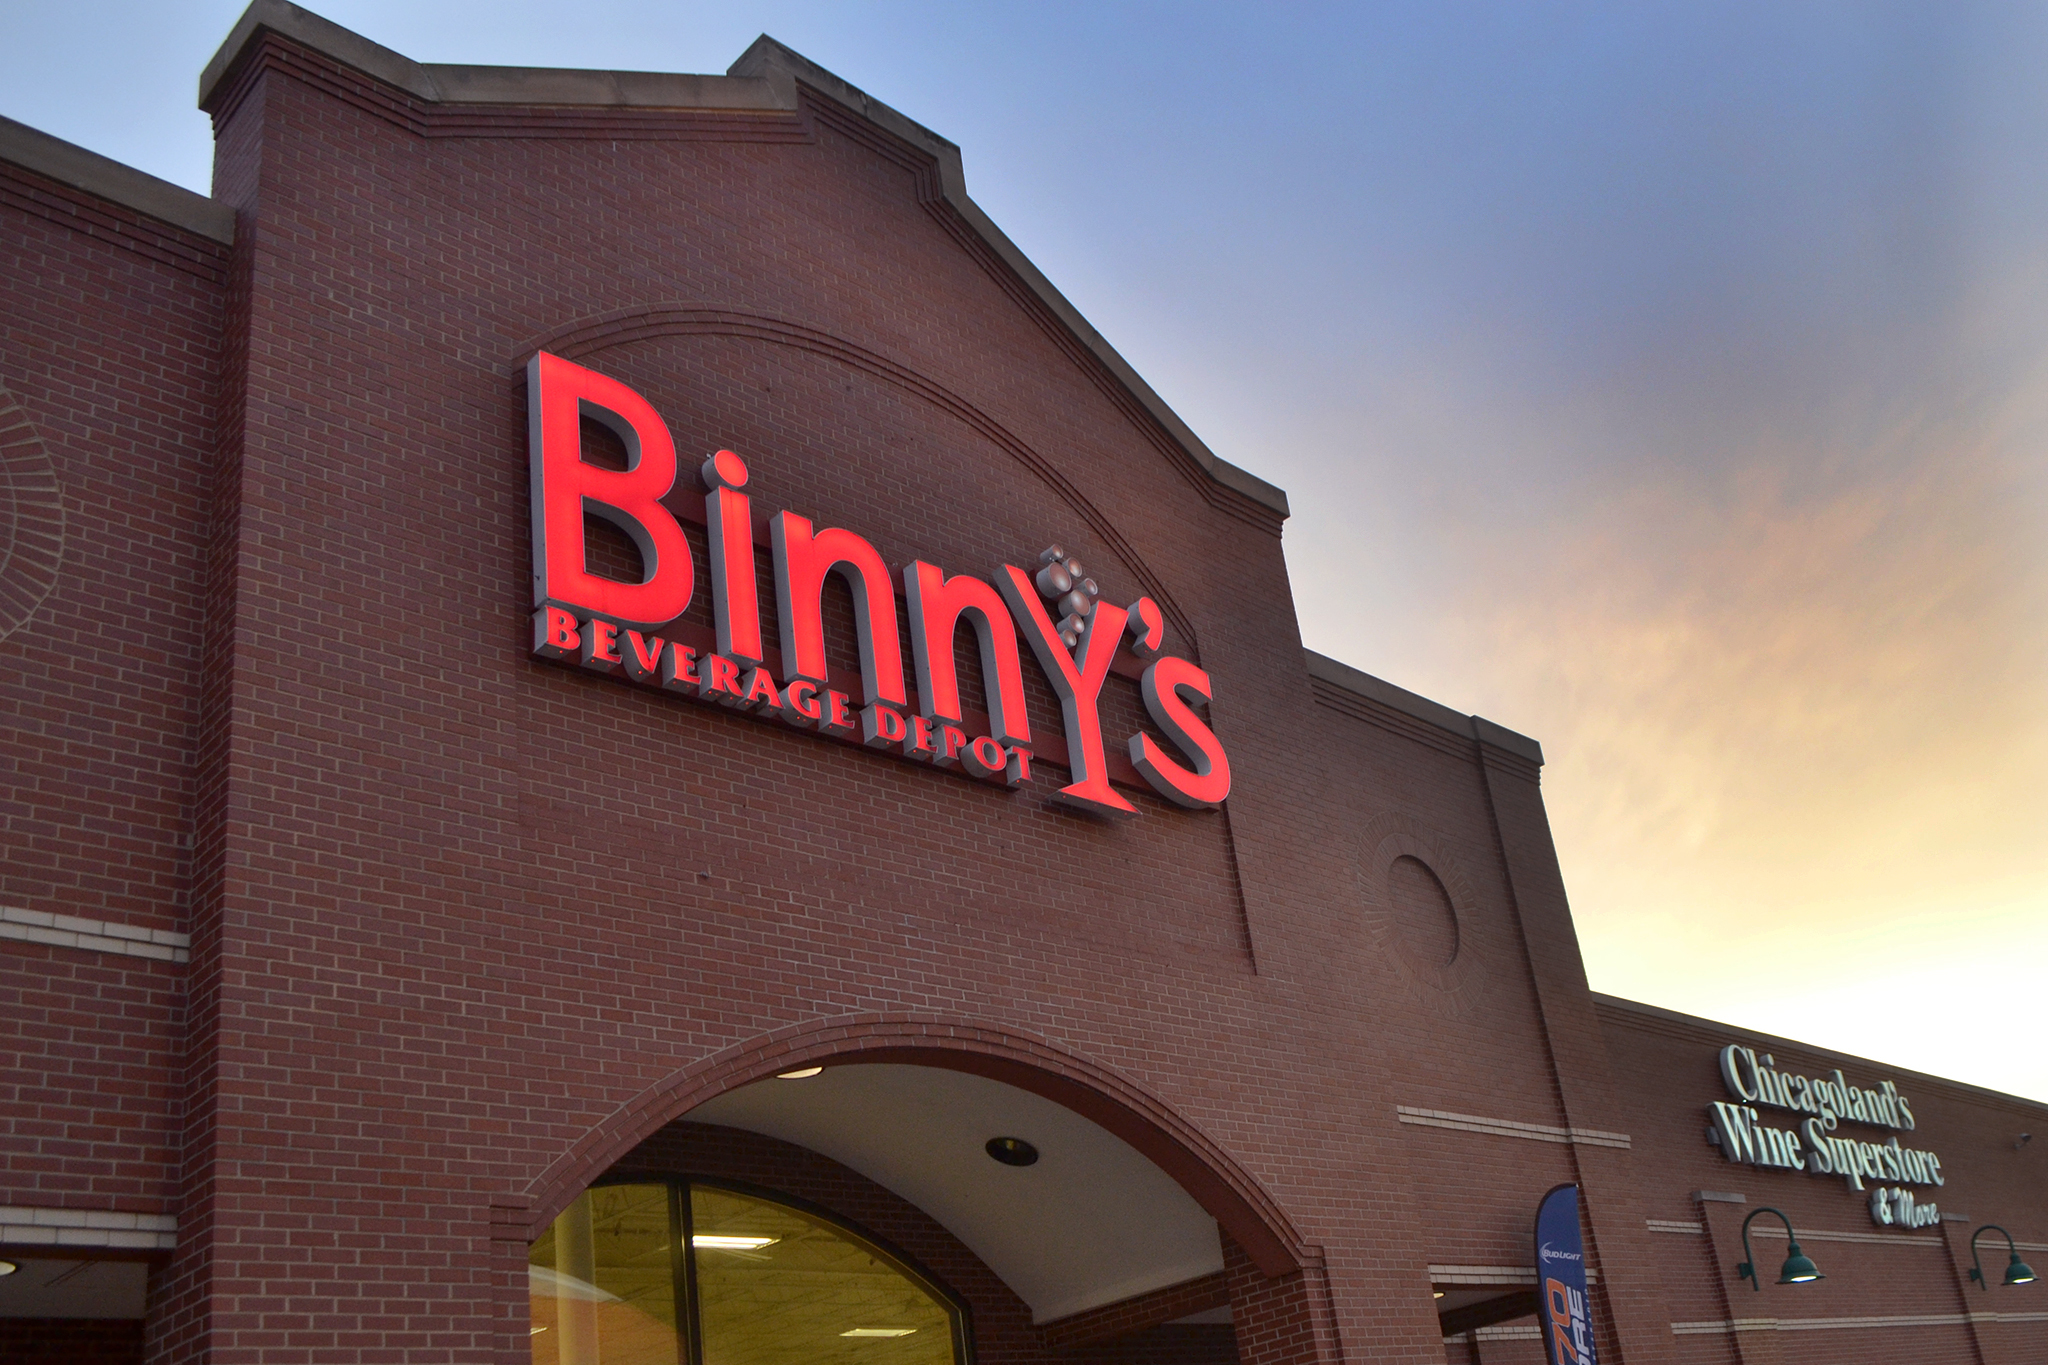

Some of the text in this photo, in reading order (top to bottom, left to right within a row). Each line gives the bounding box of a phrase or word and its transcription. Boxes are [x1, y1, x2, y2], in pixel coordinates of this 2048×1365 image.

[538, 606, 1033, 787] BEVERAGE DEPOT
[1720, 1044, 1915, 1130] Chicagoland's
[1710, 1101, 1944, 1191] Wine Superstore
[1874, 1187, 1940, 1229] & More
